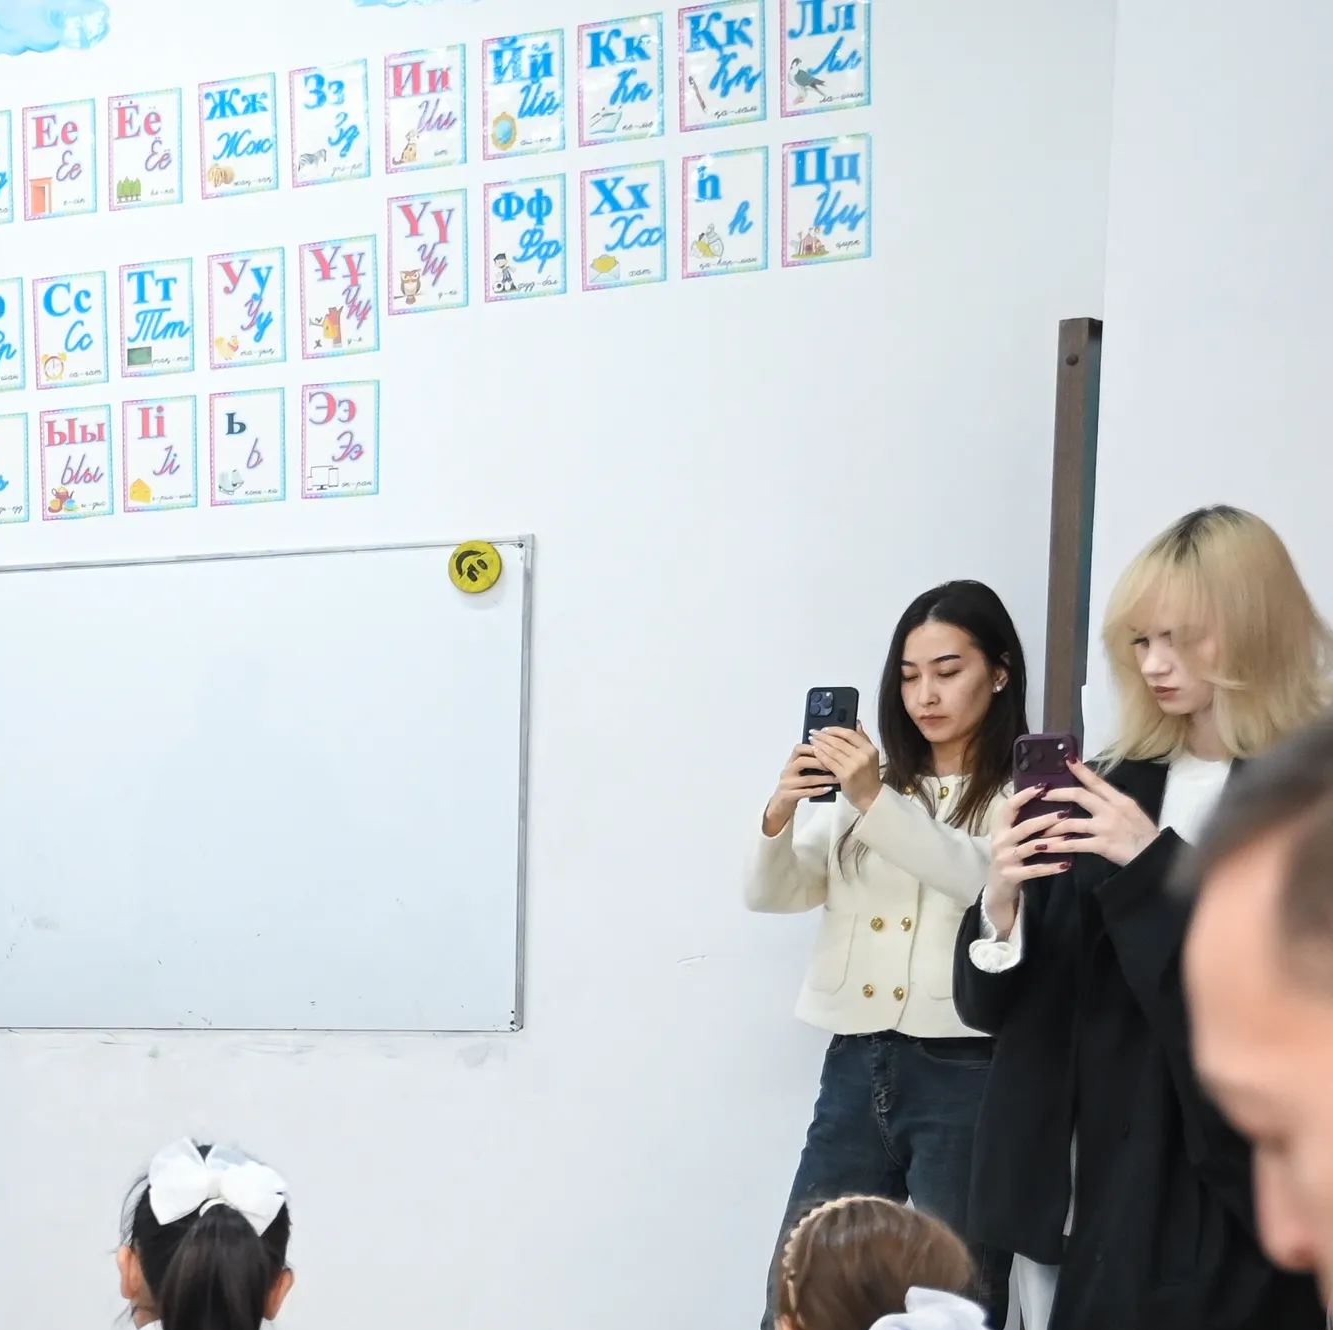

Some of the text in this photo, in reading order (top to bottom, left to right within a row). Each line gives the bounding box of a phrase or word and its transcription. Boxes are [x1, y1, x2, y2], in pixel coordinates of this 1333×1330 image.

[686, 12, 753, 54] Ққ
[788, 0, 856, 39] Лл
[490, 36, 554, 85] Йй
[587, 29, 651, 68] Кк
[304, 73, 345, 109] Зз
[389, 60, 452, 99] Ии
[114, 100, 161, 139] Ёё
[205, 88, 268, 120] Жж
[32, 115, 78, 149] Ее
[791, 147, 861, 190] Цц
[492, 188, 553, 226] Фф
[590, 177, 651, 216] Хх
[398, 202, 455, 243] Үү
[218, 260, 273, 302] Уу
[309, 246, 366, 286] Ұұ
[43, 282, 92, 317] Сс
[127, 270, 177, 304] Тт
[138, 405, 166, 440] Іі
[309, 391, 356, 425] Ээ
[45, 418, 106, 447] Ыы
